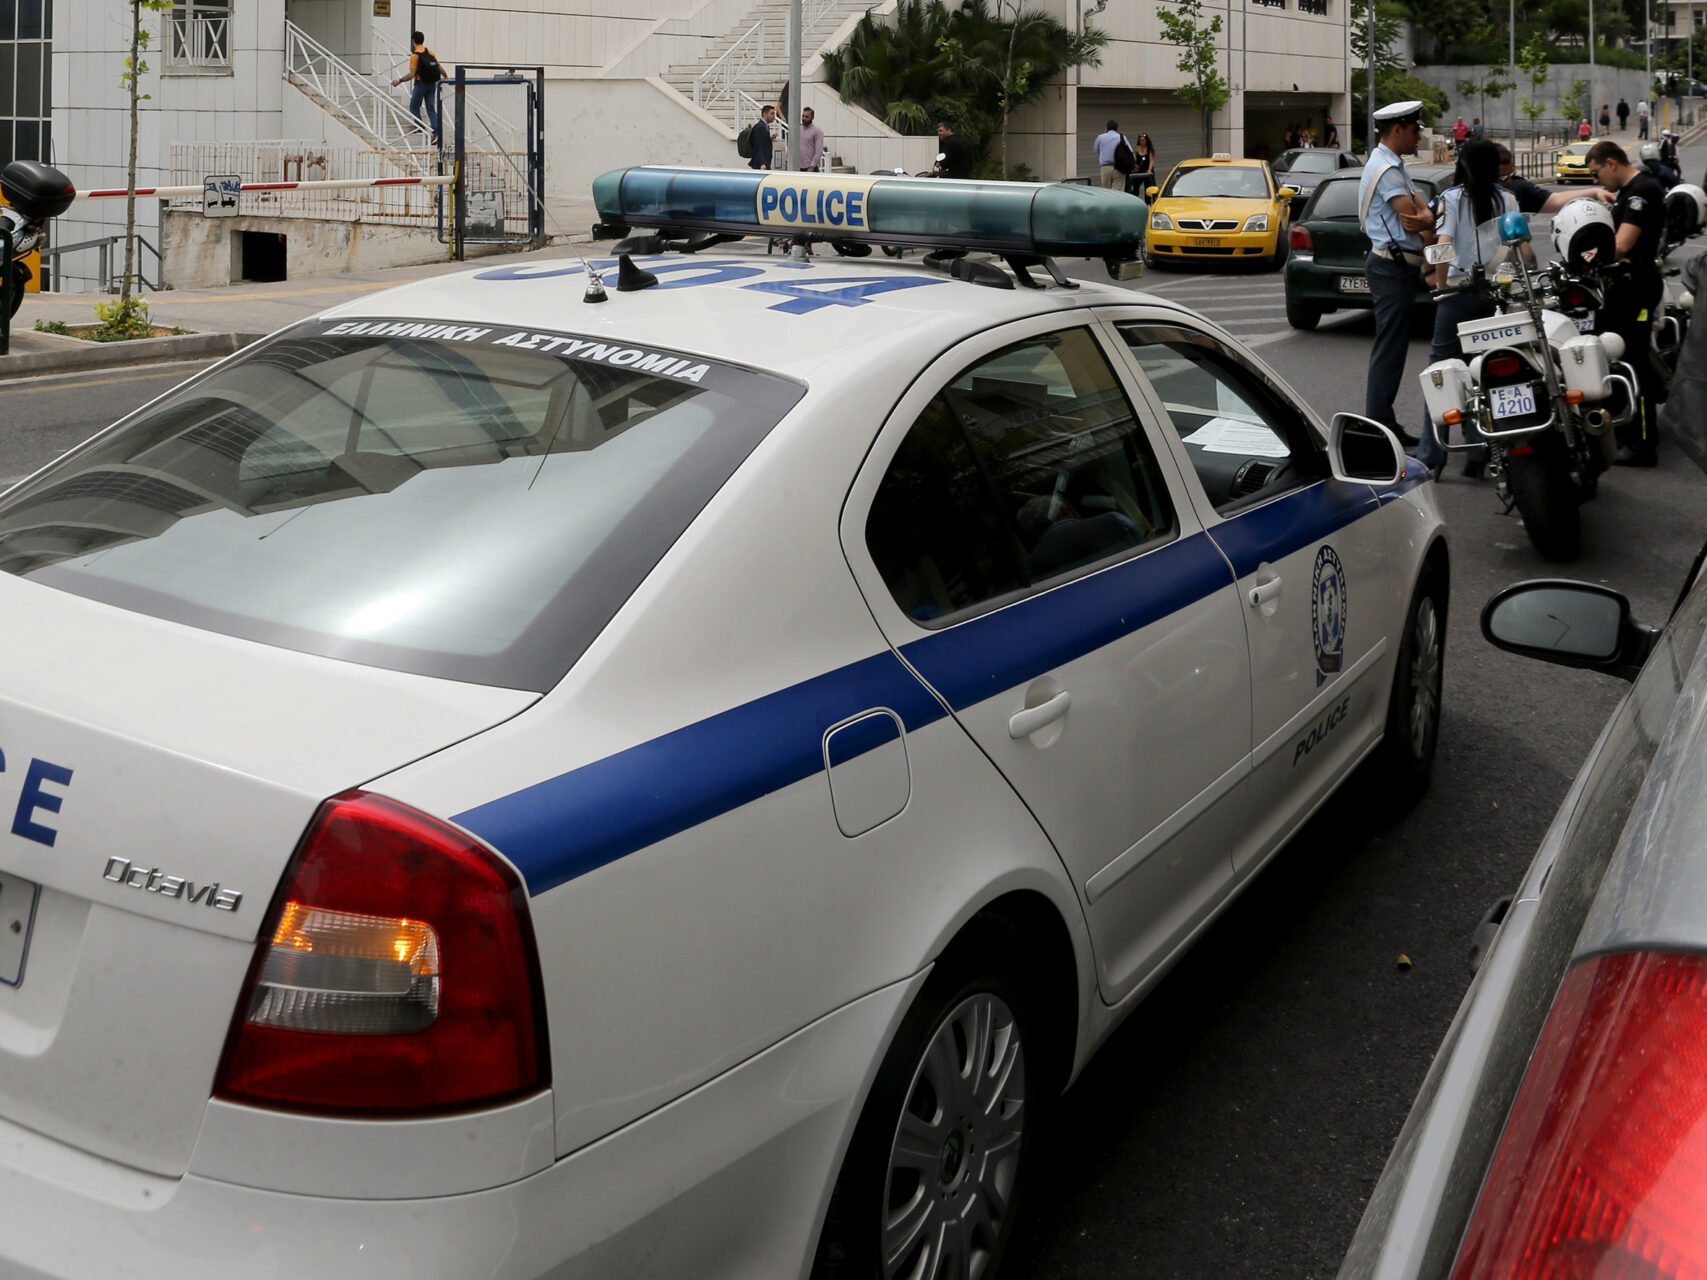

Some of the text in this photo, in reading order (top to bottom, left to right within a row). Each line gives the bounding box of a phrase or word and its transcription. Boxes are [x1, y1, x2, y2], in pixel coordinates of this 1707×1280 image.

[762, 187, 864, 226] POLICE
[322, 322, 711, 384] ΕΛΛΗΝΙΚΗ ΑΣΤΥΝΟΜΙΑ
[1471, 326, 1523, 344] POLICE
[1497, 396, 1533, 417] 4210
[1293, 695, 1350, 767] POLICE
[0, 747, 74, 848] E
[103, 855, 243, 913] Octavia
